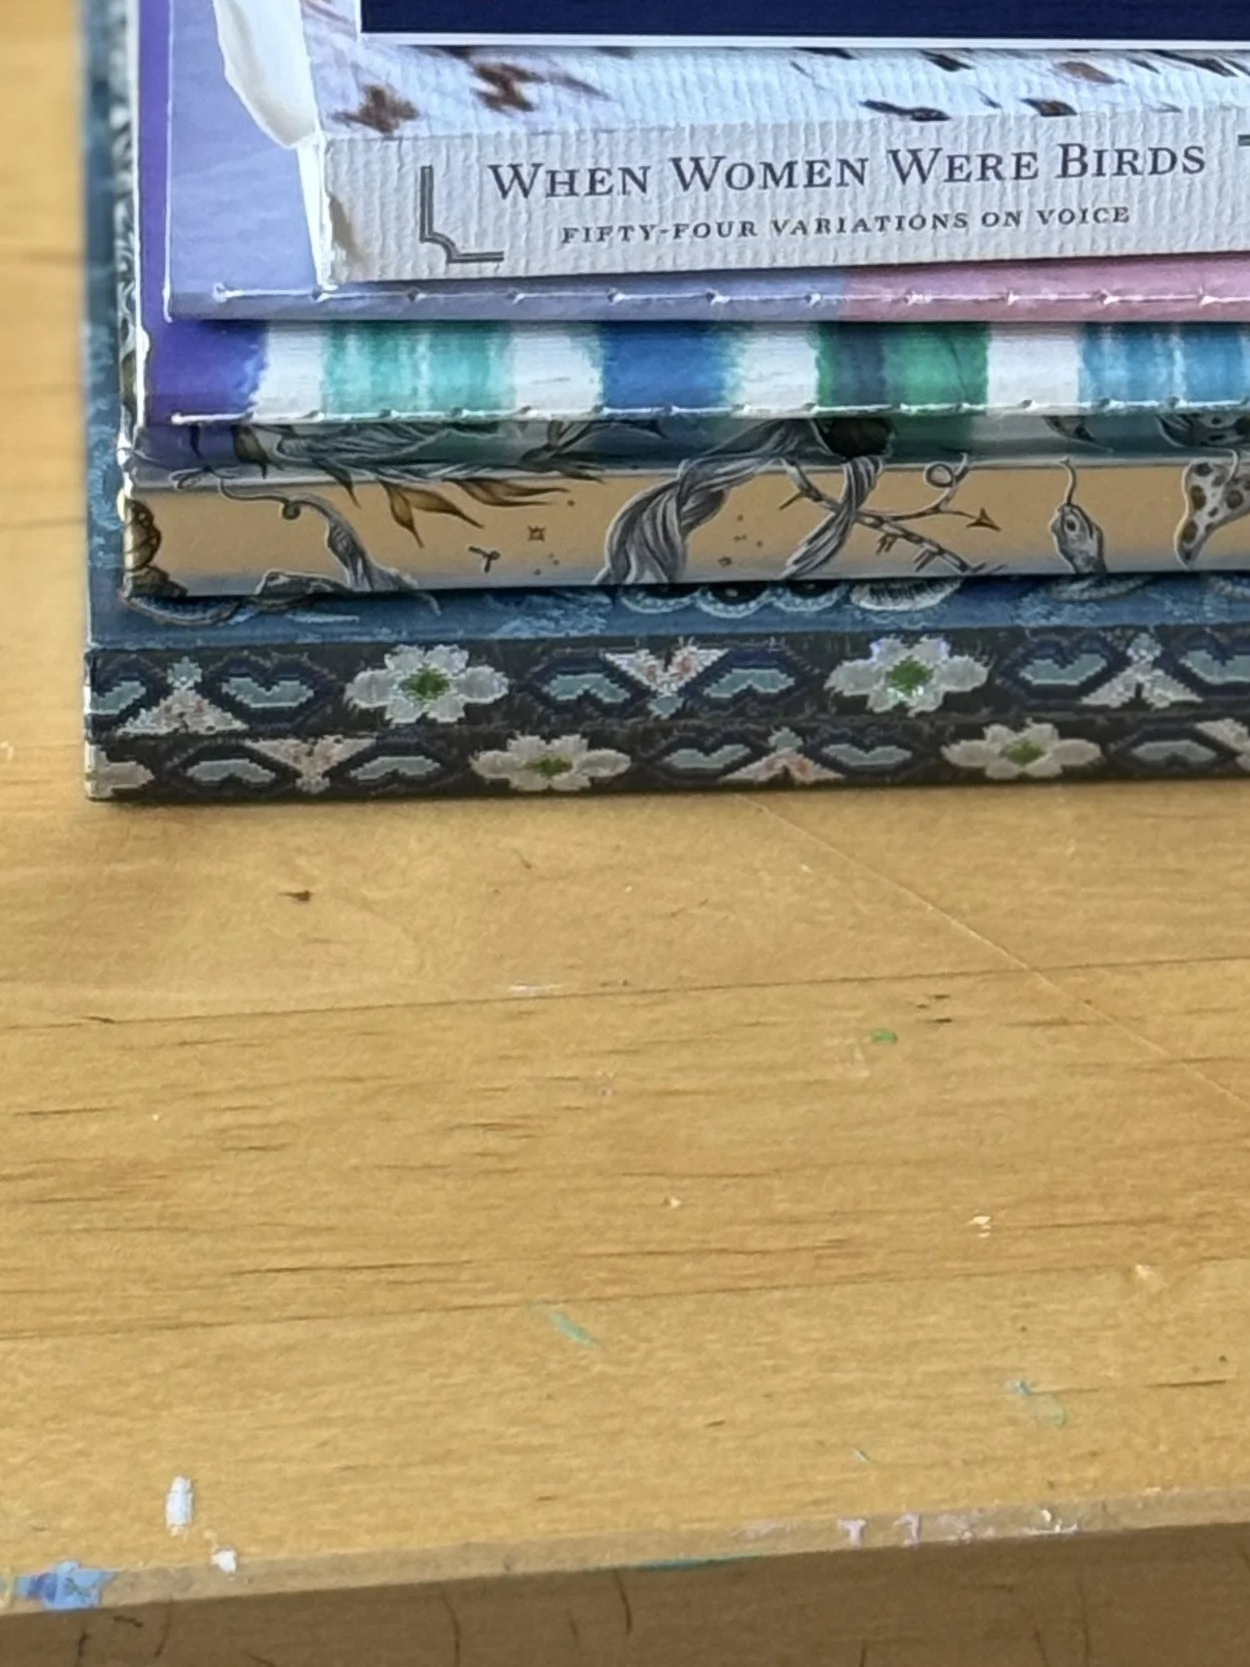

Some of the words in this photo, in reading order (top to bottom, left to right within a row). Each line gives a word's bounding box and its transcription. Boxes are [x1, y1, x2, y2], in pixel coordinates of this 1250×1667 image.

[489, 163, 651, 200] WHEN
[669, 156, 869, 195] WOMEN
[889, 146, 1040, 186] WERE
[1056, 141, 1206, 178] BIRDS
[561, 219, 757, 245] FIFTY-FOUR
[770, 211, 966, 239] VARIATIONS
[980, 209, 1023, 230] ON
[1037, 205, 1130, 227] VOICE
